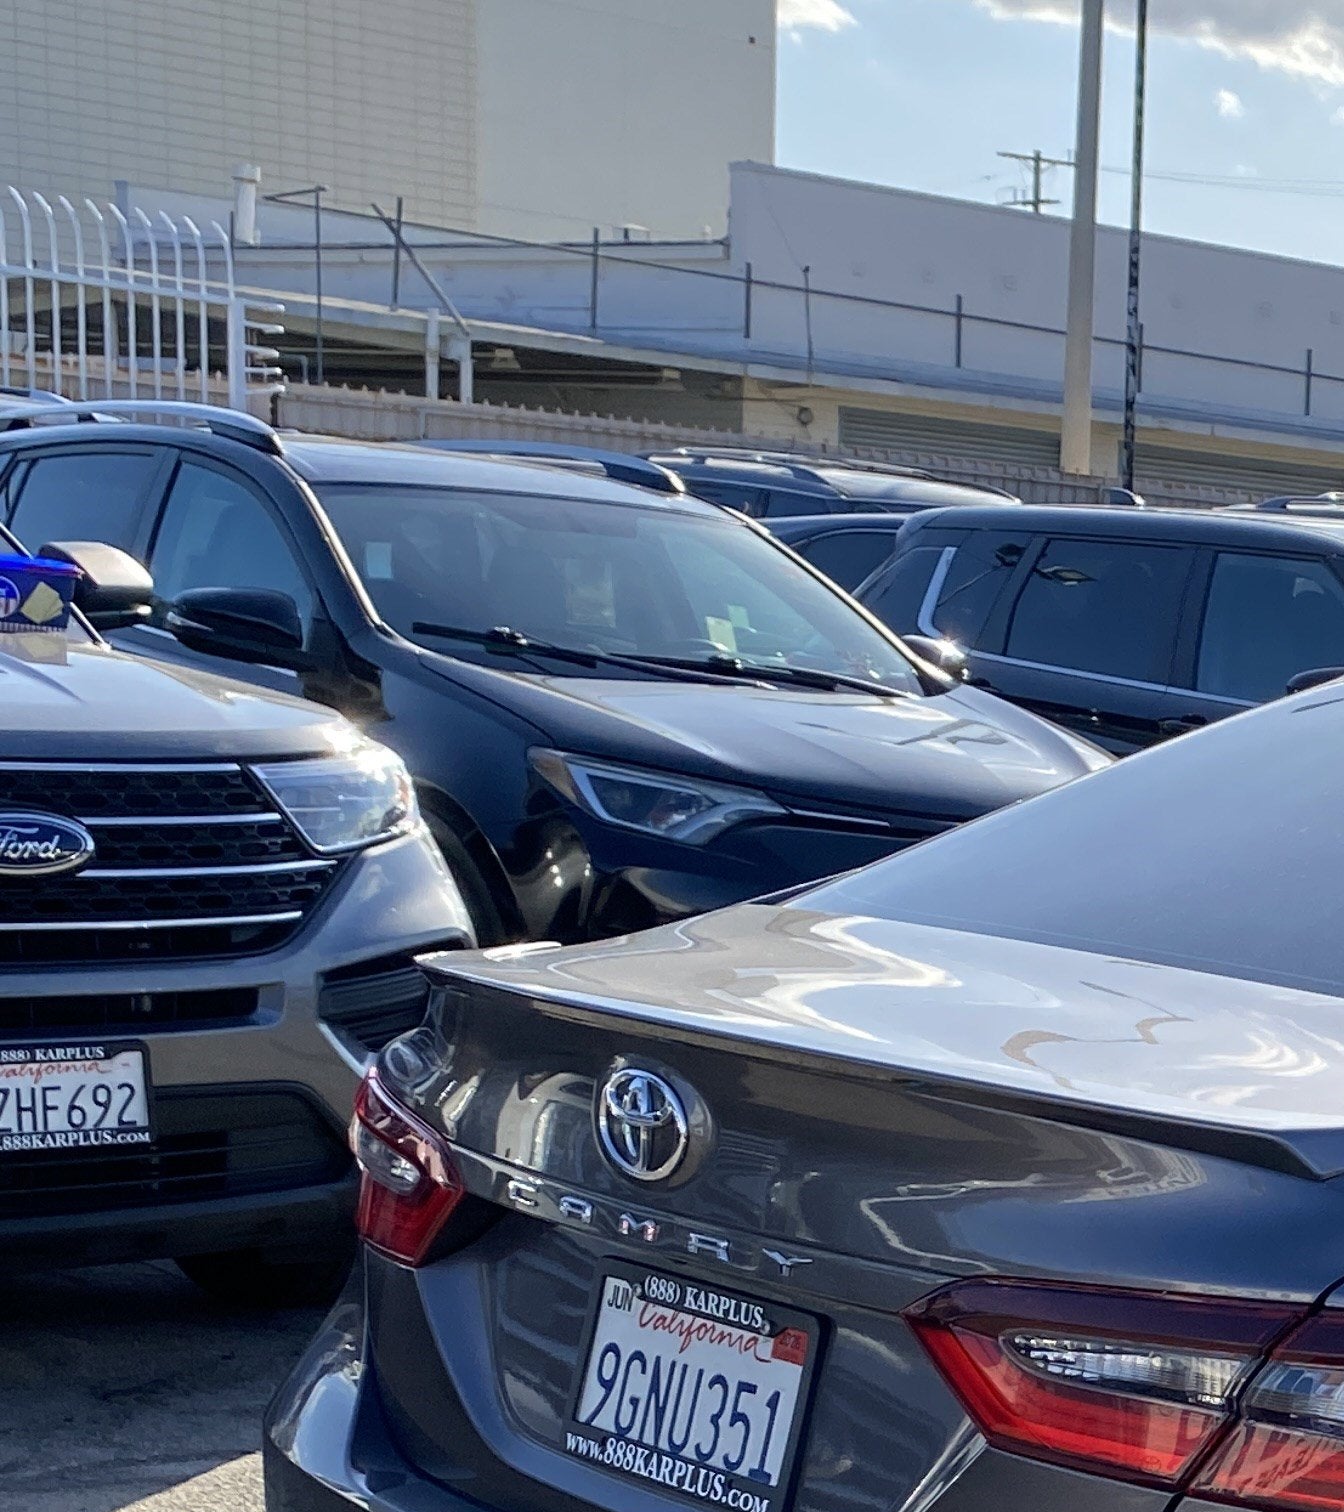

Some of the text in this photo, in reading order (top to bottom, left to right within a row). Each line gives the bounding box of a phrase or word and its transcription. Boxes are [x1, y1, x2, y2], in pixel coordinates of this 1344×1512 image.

[0, 825, 61, 860] Ford
[0, 1061, 112, 1084] alifornia
[35, 1046, 105, 1061] KARPLUS
[508, 1179, 813, 1277] CAMRY
[607, 1284, 632, 1312] JUN
[644, 1275, 764, 1328] (888) KARPLUS
[639, 1301, 772, 1363] California
[585, 1342, 781, 1484] 9GNU351
